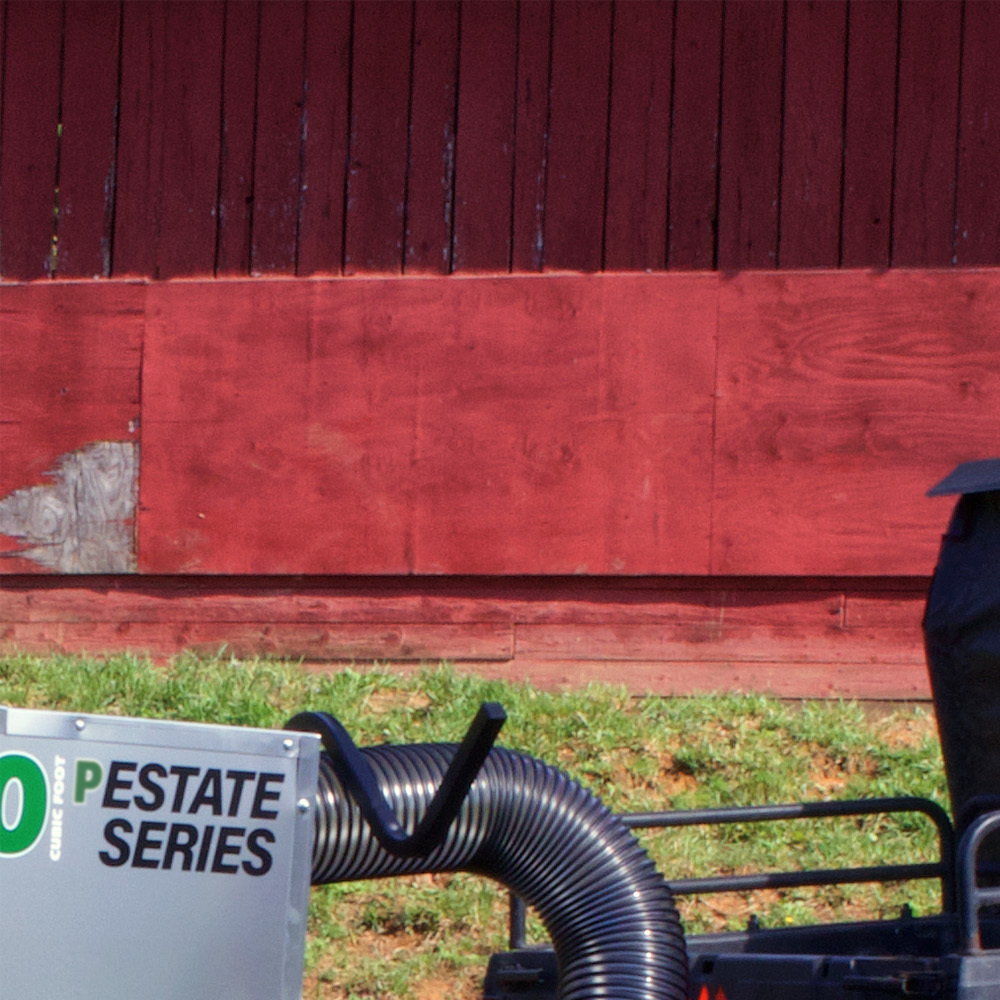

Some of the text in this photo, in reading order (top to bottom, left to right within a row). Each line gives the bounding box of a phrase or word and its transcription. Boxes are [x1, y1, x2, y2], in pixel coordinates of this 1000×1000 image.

[50, 754, 66, 861] CUBIC FOOT
[98, 818, 276, 876] SERIES
